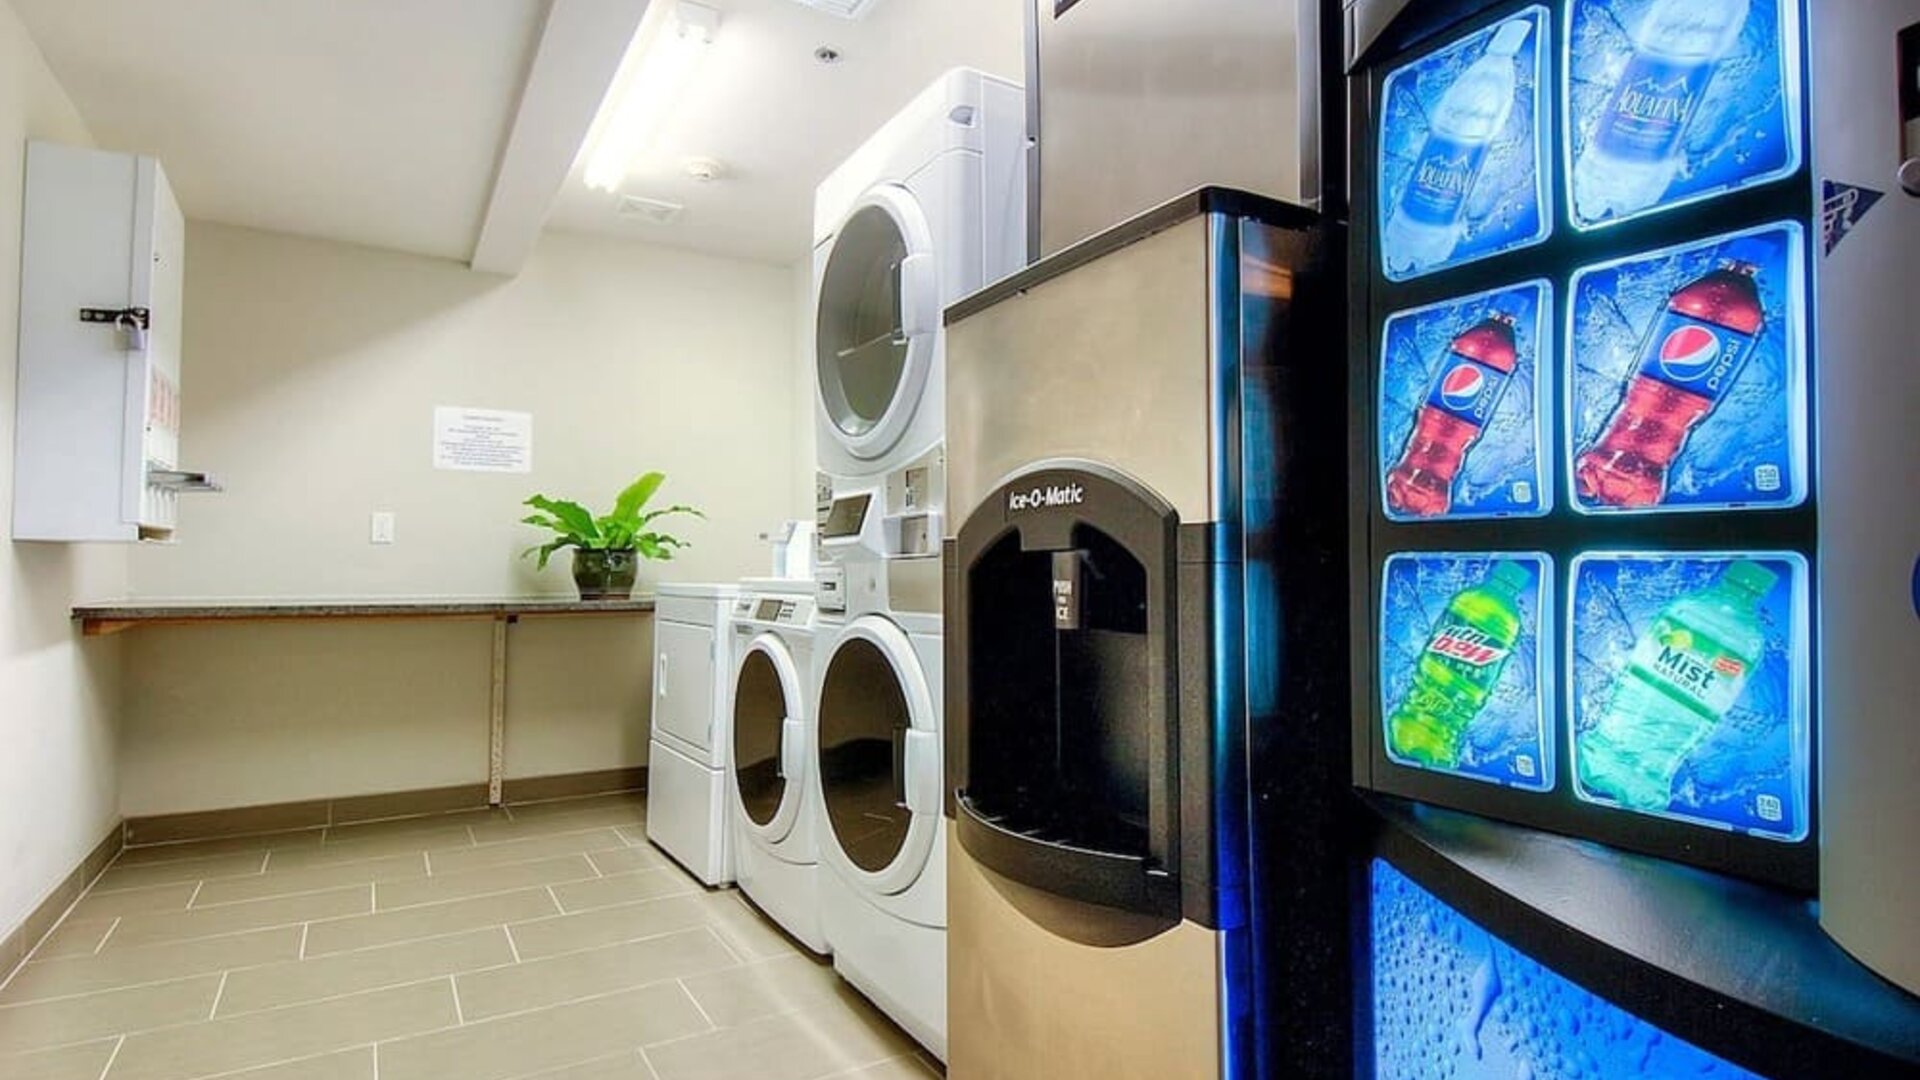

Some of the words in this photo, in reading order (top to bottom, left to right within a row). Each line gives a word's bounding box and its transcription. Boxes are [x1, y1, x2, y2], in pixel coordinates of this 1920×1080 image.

[1706, 337, 1741, 391] pepsi
[1474, 375, 1499, 418] pepsi
[1009, 483, 1083, 510] Ice-O-Matic
[1659, 646, 1715, 689] Mist
